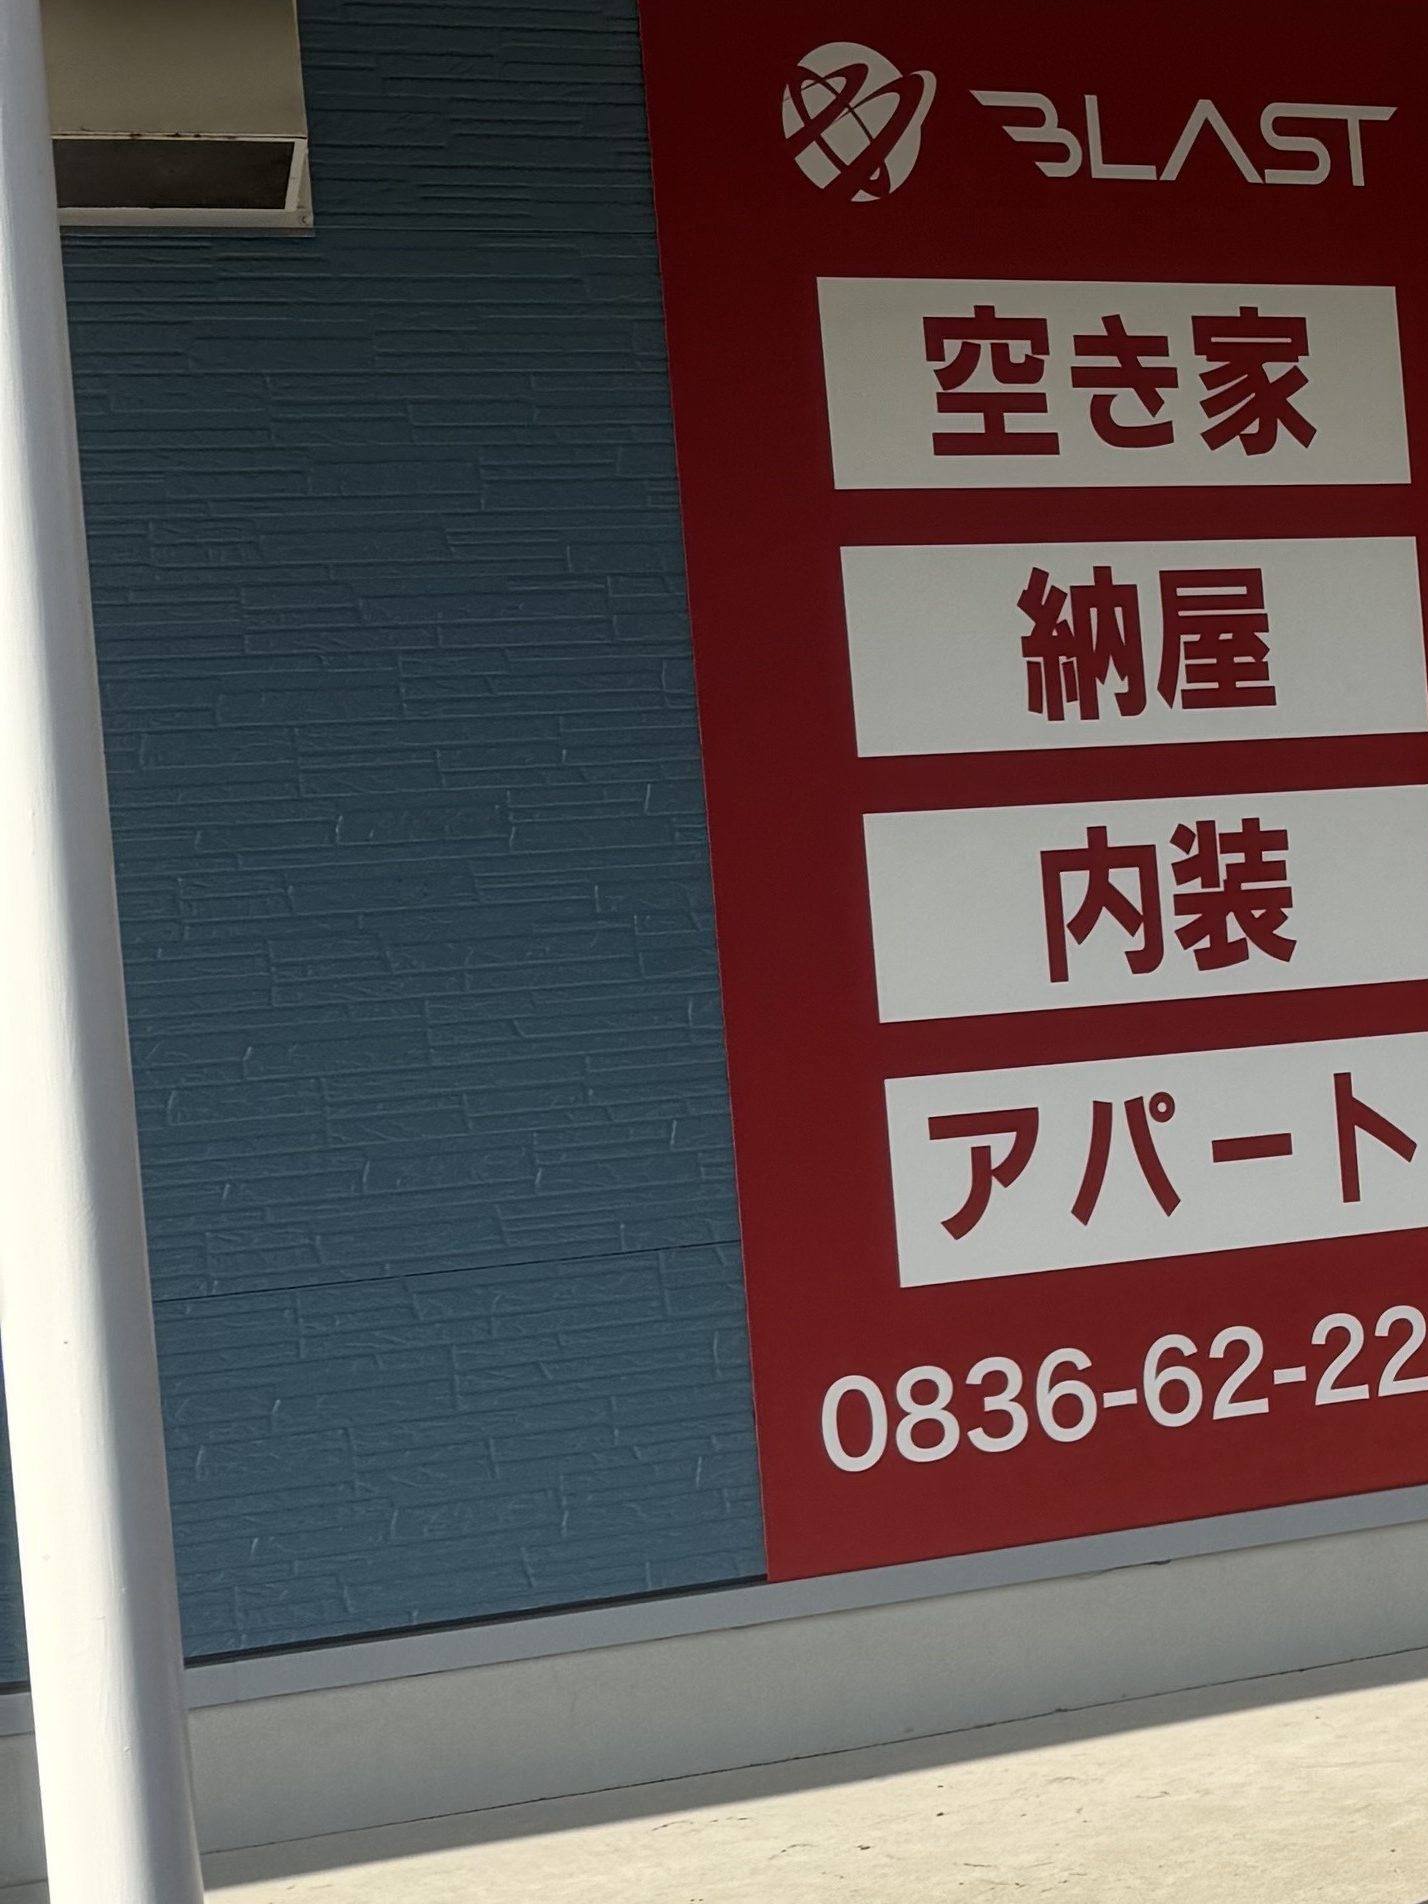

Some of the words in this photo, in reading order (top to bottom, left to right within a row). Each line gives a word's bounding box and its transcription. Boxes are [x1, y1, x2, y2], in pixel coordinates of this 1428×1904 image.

[970, 90, 1397, 187] BLAST
[922, 304, 1318, 457] 空き家
[1016, 565, 1277, 722] 納屋
[1040, 817, 1298, 984] 内装
[927, 1072, 1417, 1241] アパート
